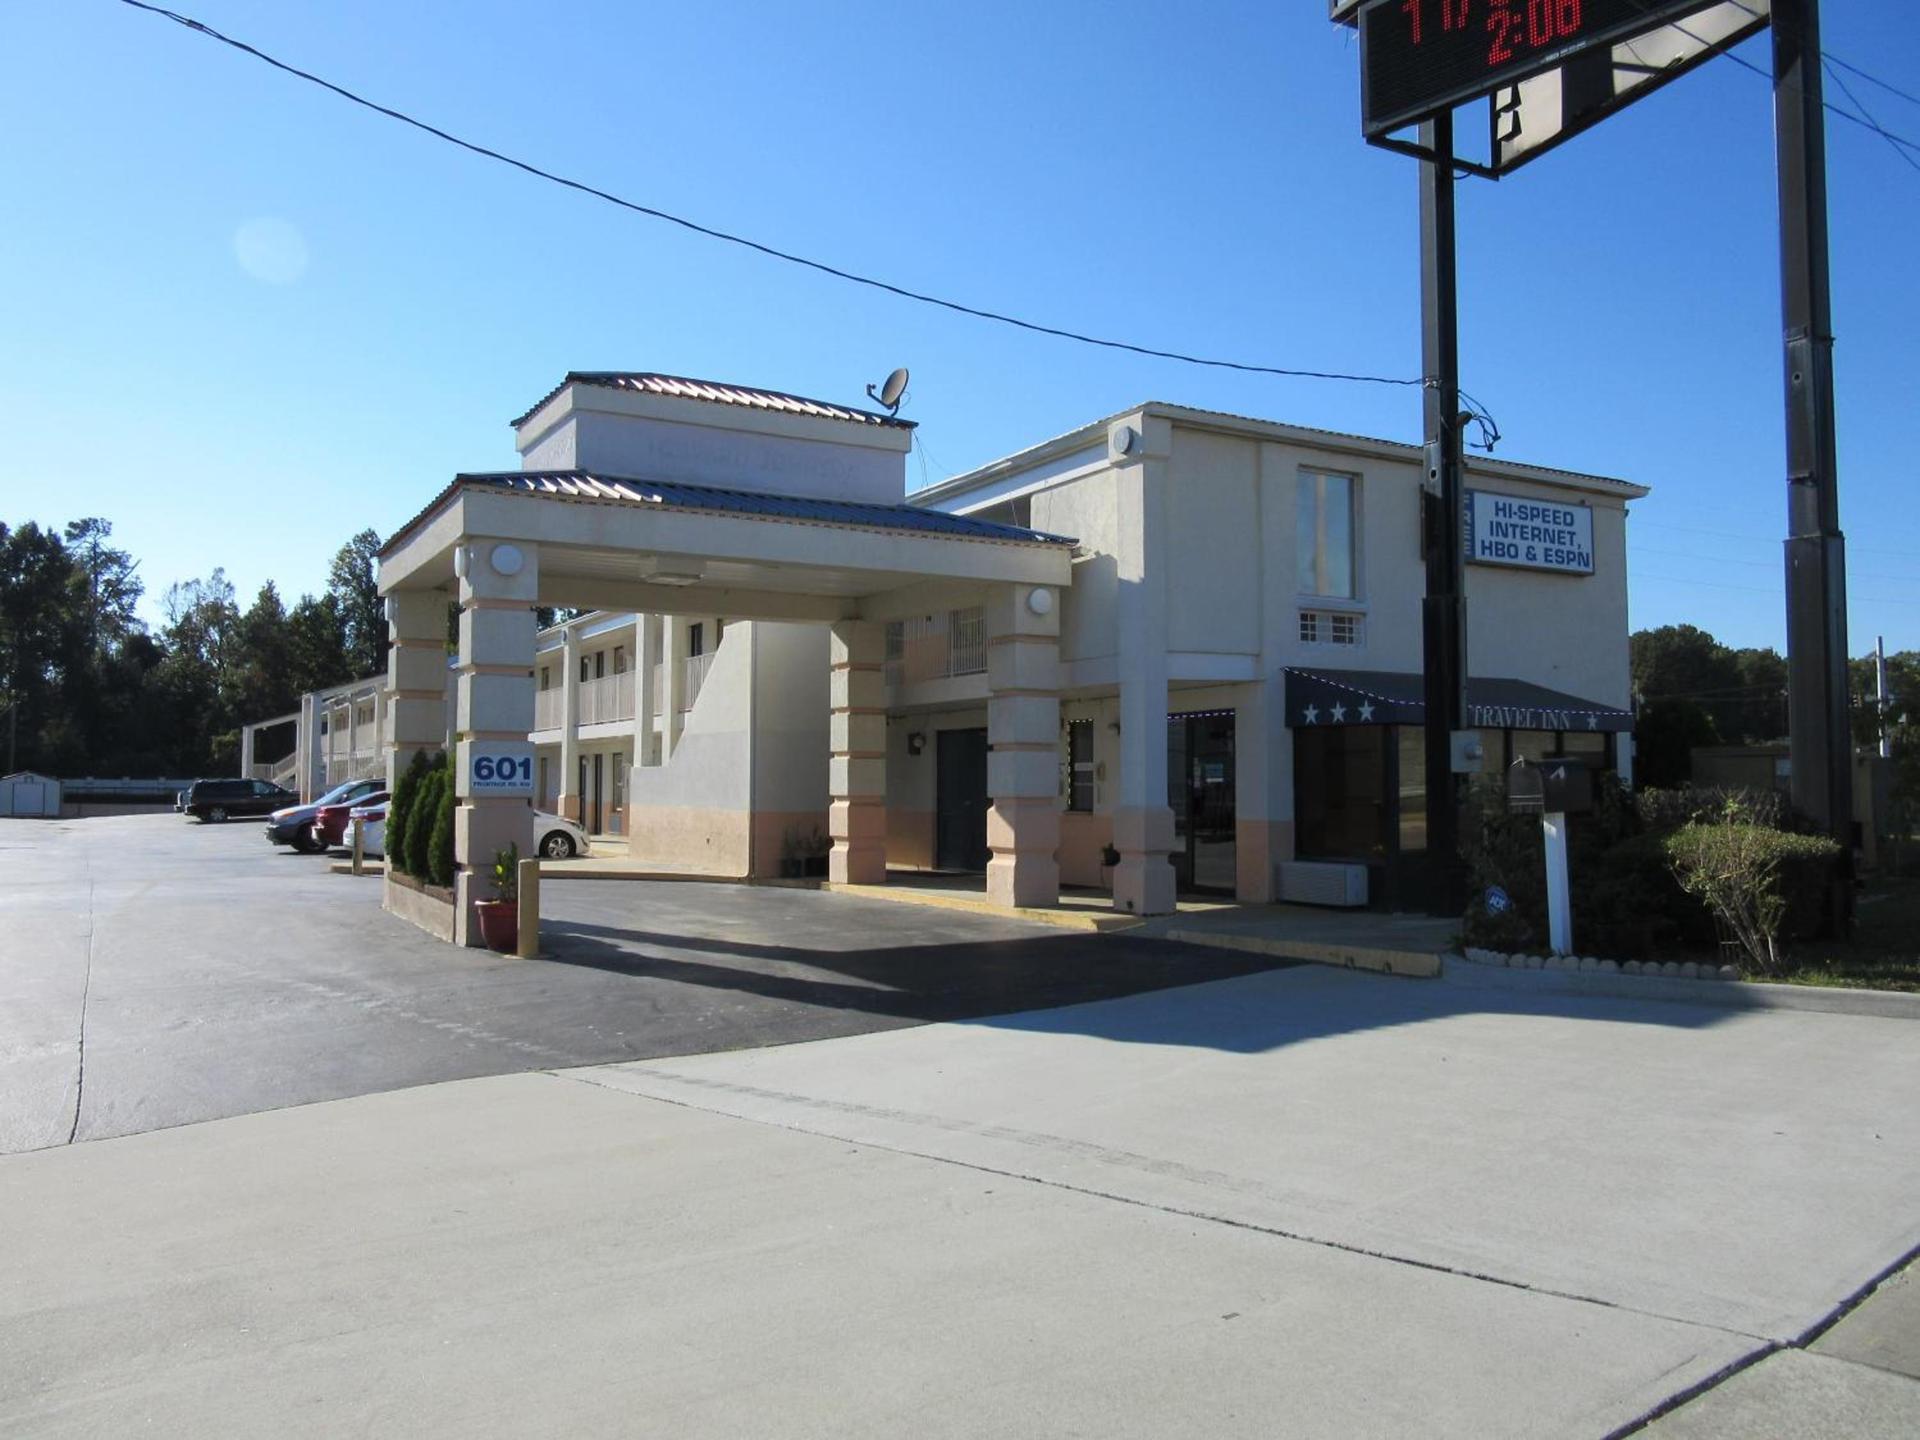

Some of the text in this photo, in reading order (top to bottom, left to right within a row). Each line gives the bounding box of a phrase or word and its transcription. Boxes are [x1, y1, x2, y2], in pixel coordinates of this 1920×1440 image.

[1494, 501, 1575, 527] HI-SPEED
[1489, 520, 1582, 549] INTERNET,
[1480, 540, 1590, 569] HBO & ESPN
[1474, 706, 1570, 730] TRAVEL INN
[474, 756, 531, 780] 601
